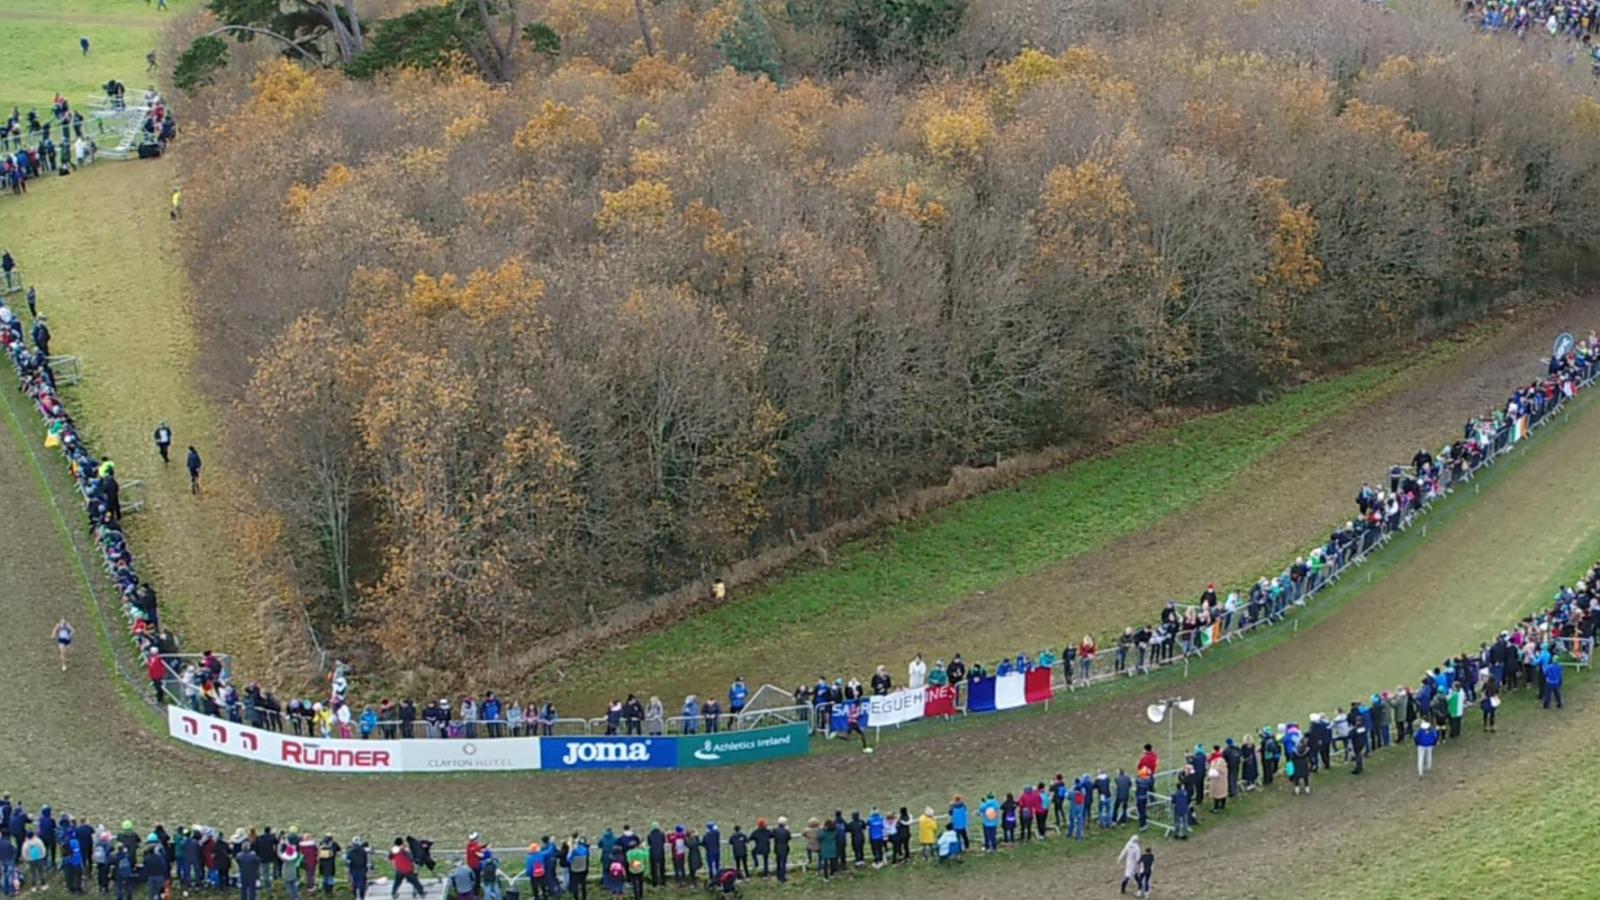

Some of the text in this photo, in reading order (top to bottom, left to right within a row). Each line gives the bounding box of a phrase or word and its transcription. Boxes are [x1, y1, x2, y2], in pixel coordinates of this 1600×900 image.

[713, 735, 791, 752] Athletics Ireland
[428, 760, 472, 768] CLAYTON
